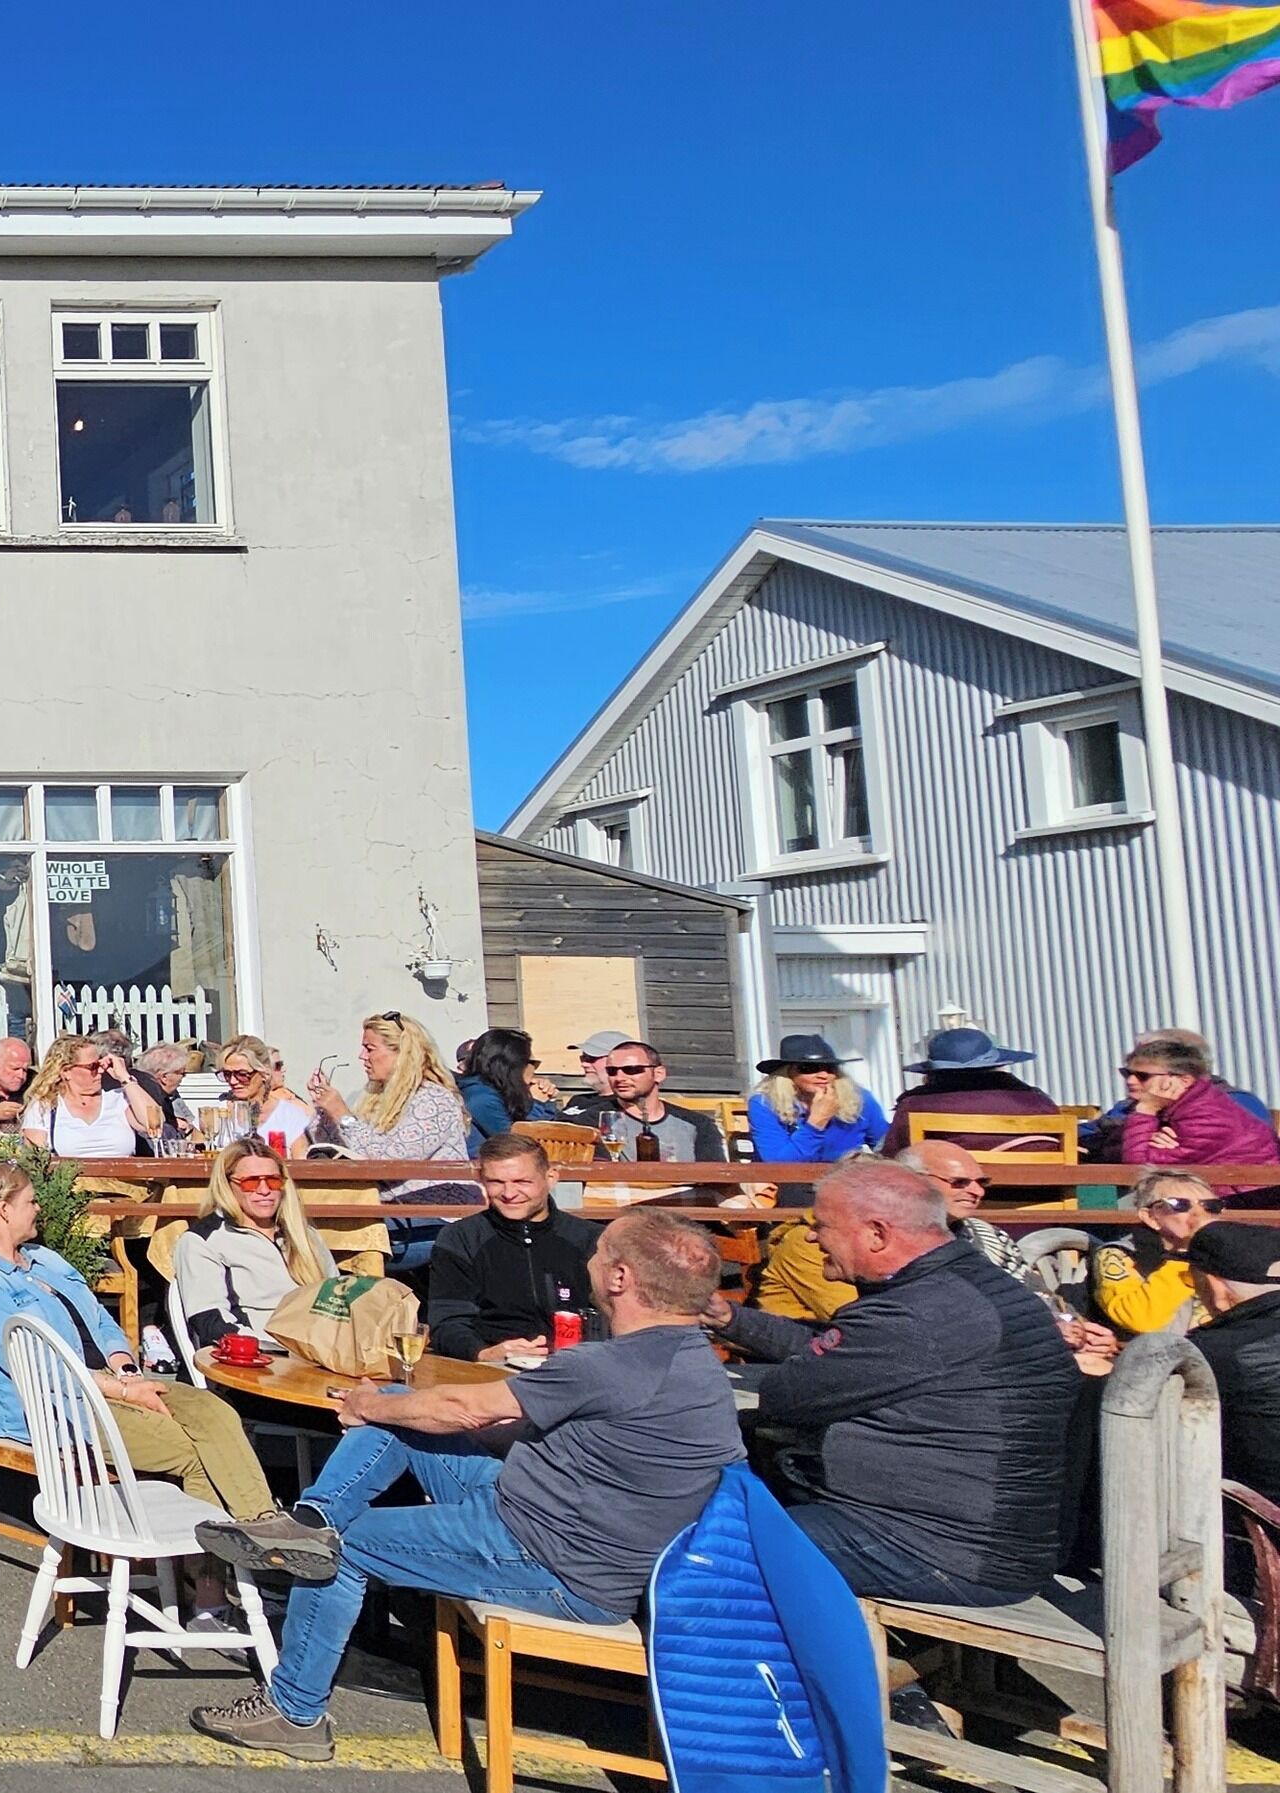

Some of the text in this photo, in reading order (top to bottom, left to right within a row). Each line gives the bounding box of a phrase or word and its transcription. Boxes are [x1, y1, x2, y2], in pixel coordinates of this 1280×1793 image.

[46, 862, 105, 874] WHOLE
[48, 876, 108, 888] LATTE
[47, 890, 90, 901] LOVE
